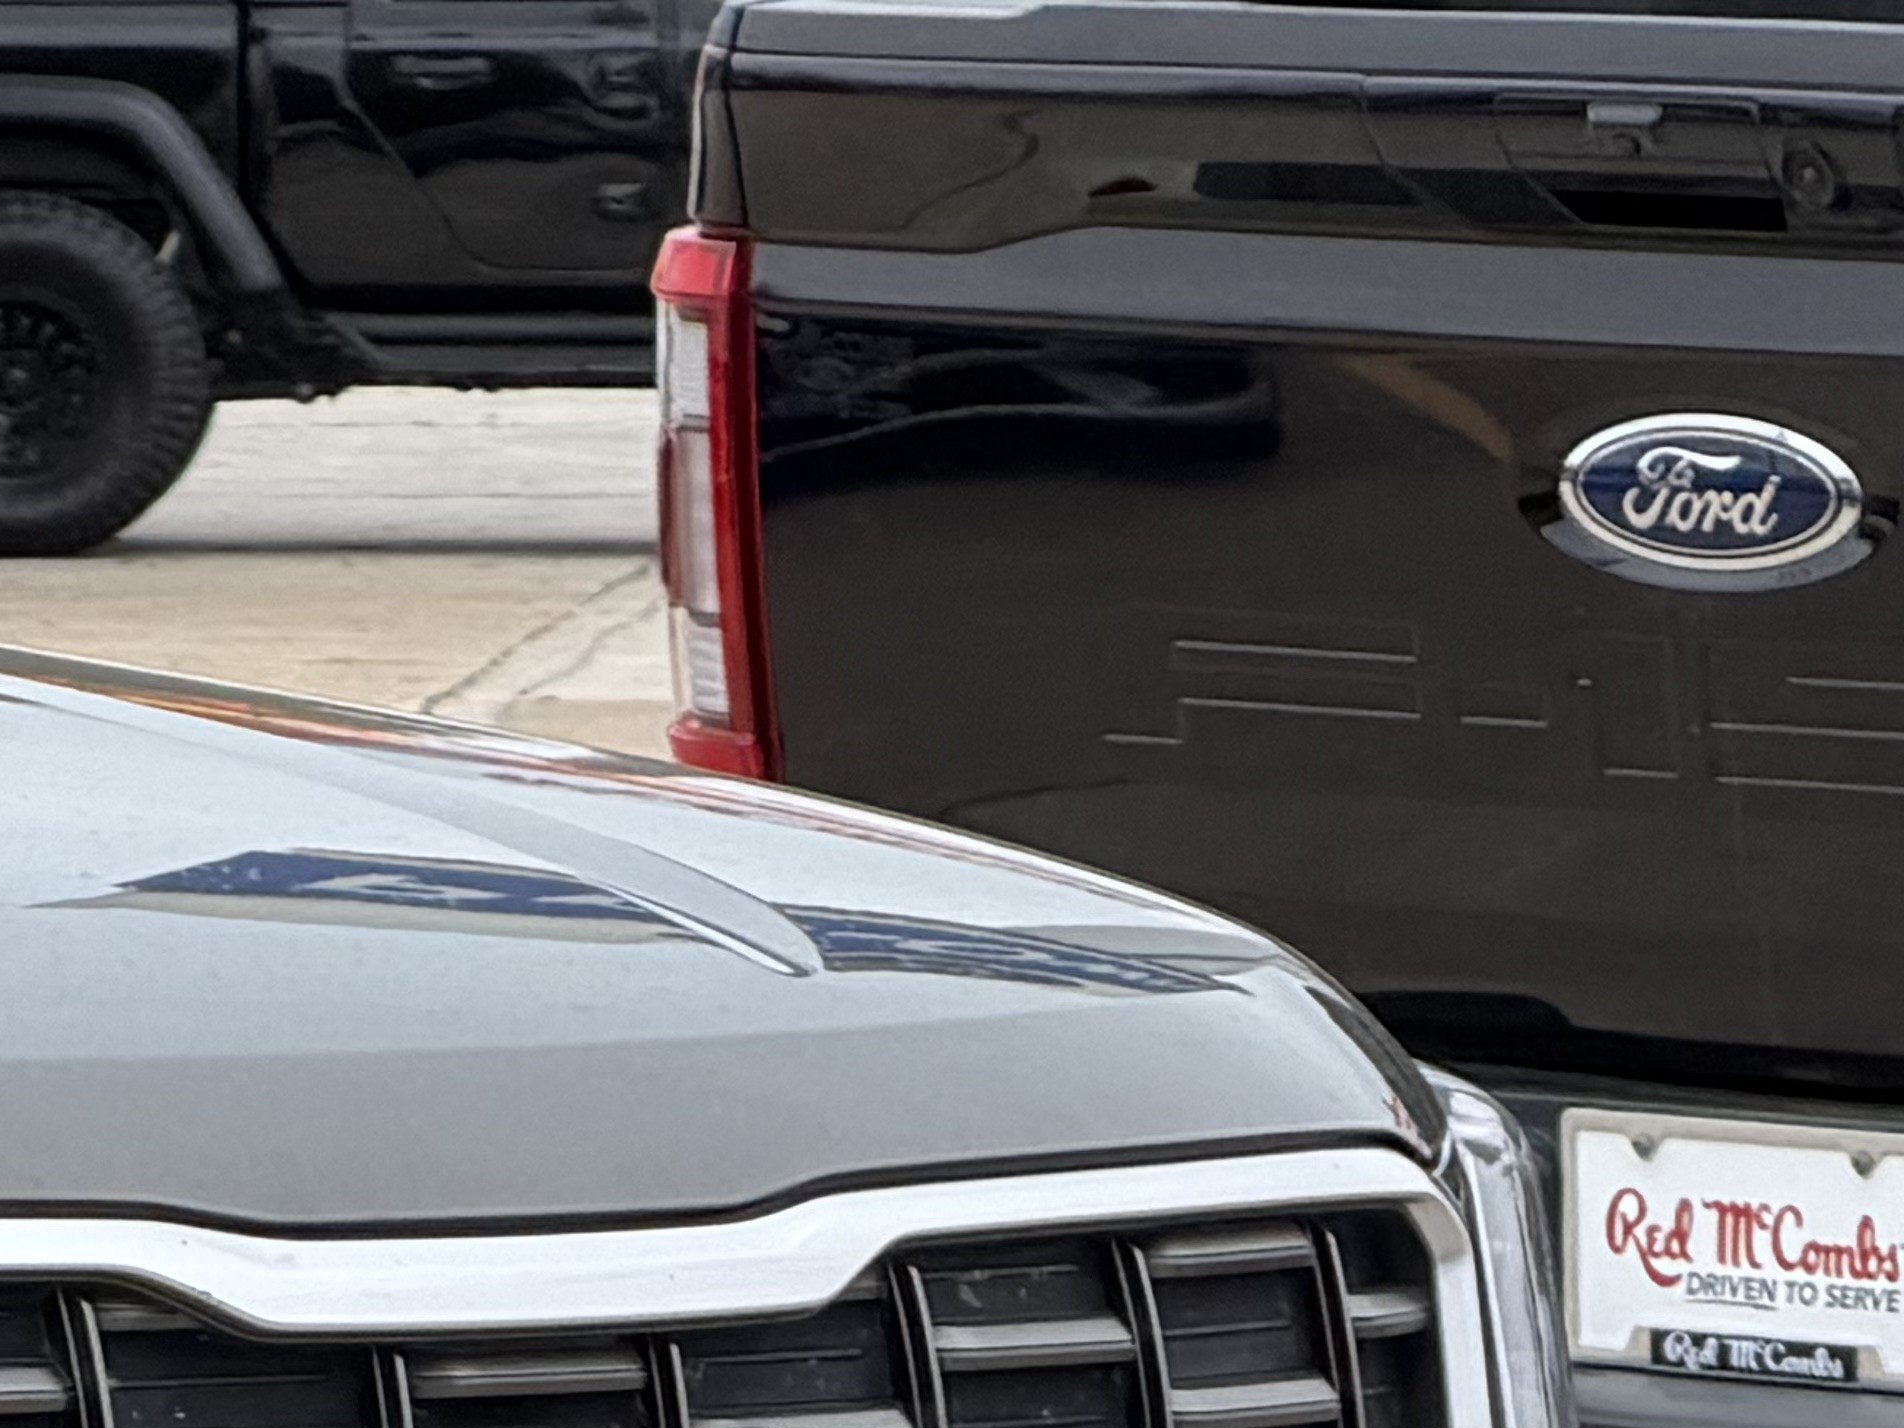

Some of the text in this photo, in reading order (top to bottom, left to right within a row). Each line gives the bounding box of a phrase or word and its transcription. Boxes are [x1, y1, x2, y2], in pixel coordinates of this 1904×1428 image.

[1622, 446, 1780, 536] Ford
[1605, 1187, 1900, 1287] Red McCombs
[1686, 1271, 1902, 1314] DRIVEN TO SERVE
[1663, 1330, 1845, 1379] Red McCombs
